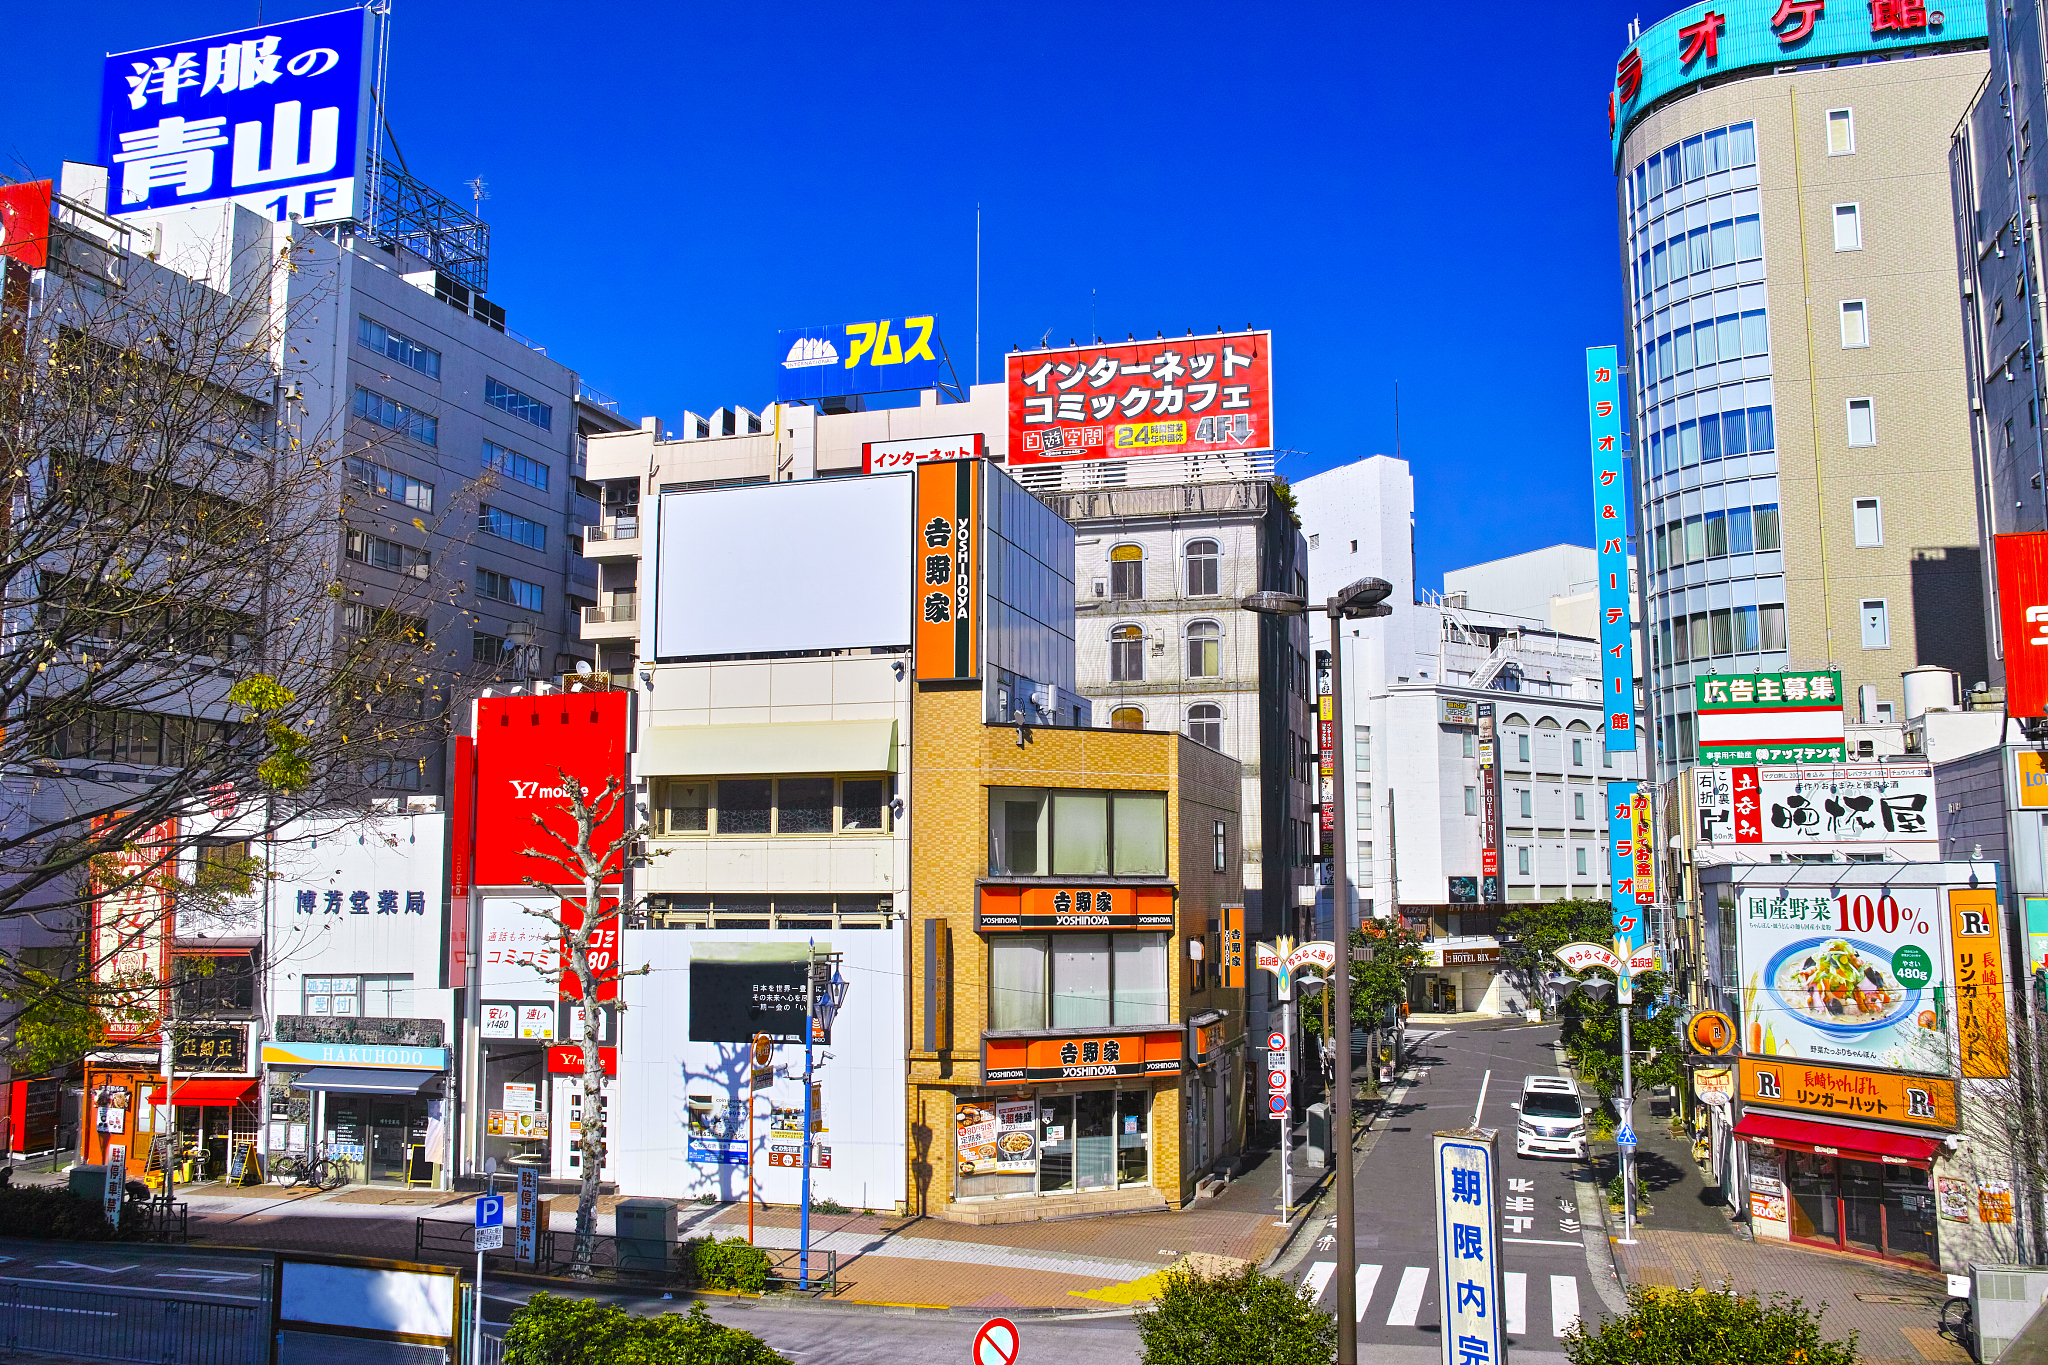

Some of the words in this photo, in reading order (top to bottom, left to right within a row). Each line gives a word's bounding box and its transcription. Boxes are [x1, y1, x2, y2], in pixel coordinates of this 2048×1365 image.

[125, 35, 339, 110] 洋服の
[1608, 0, 1928, 136] ラオケ館
[112, 100, 339, 205] 青山
[845, 316, 936, 369] アムス
[1023, 345, 1253, 393] インターネット
[1023, 381, 1252, 424] コミックカフェ
[1025, 428, 1102, 449] 自遊空間
[1118, 424, 1150, 446] 24
[1196, 415, 1232, 444] 4F
[1594, 367, 1630, 731] カラオケ&パーティー館
[924, 516, 952, 624] 吉野家
[957, 518, 969, 619] YOSHINOYA
[1703, 676, 1836, 704] 広告主募集
[1699, 774, 1714, 805] 右折
[1717, 771, 1730, 805] この裏
[1486, 788, 1494, 822] HOTEL
[1734, 773, 1759, 838] 立呑み
[1633, 796, 1652, 877] カードでお金
[1614, 803, 1638, 933] カラオケ
[297, 890, 426, 916] 博芳堂薬局
[1053, 890, 1113, 913] 吉野家
[1637, 893, 1654, 902] 4F
[1056, 915, 1110, 926] YOSHINOYA
[1749, 897, 1831, 921] 国産野菜
[1833, 894, 1929, 935] 100%
[487, 949, 549, 965] コミコミ
[1259, 956, 1279, 966] 五反田
[1452, 954, 1476, 963] HOTEL
[1477, 953, 1490, 962] BIX
[1566, 951, 1619, 968] ゆうらく通り
[1630, 958, 1653, 968] 五反田
[307, 979, 355, 993] 処方せん
[1896, 967, 1928, 981] 480g
[752, 984, 827, 993] 日本を世界一豊に。
[315, 997, 348, 1011] 受付
[489, 1008, 508, 1019] 安い
[526, 1008, 547, 1020] 速い
[1959, 953, 1981, 1061] リンガーハット
[110, 1022, 129, 1032] SINCE
[322, 1047, 423, 1065] HAKUHODO
[1060, 1040, 1120, 1065] 吉野家
[1810, 1045, 1877, 1059] 野菜たっぷりちゃんぽん
[987, 1070, 1024, 1079] YOSHINOYA
[1062, 1065, 1117, 1077] YOSHINOYA
[1146, 1061, 1180, 1070] YOSHINOYA
[1272, 1075, 1283, 1084] 30
[1804, 1071, 1879, 1095] 長崎ちゃんぽん
[1797, 1090, 1888, 1114] リンガーハット
[106, 1148, 120, 1224] 駐停車禁止
[483, 1200, 499, 1224] P
[518, 1171, 533, 1260] 駐停車禁止
[1451, 1166, 1490, 1365] 期限内完
